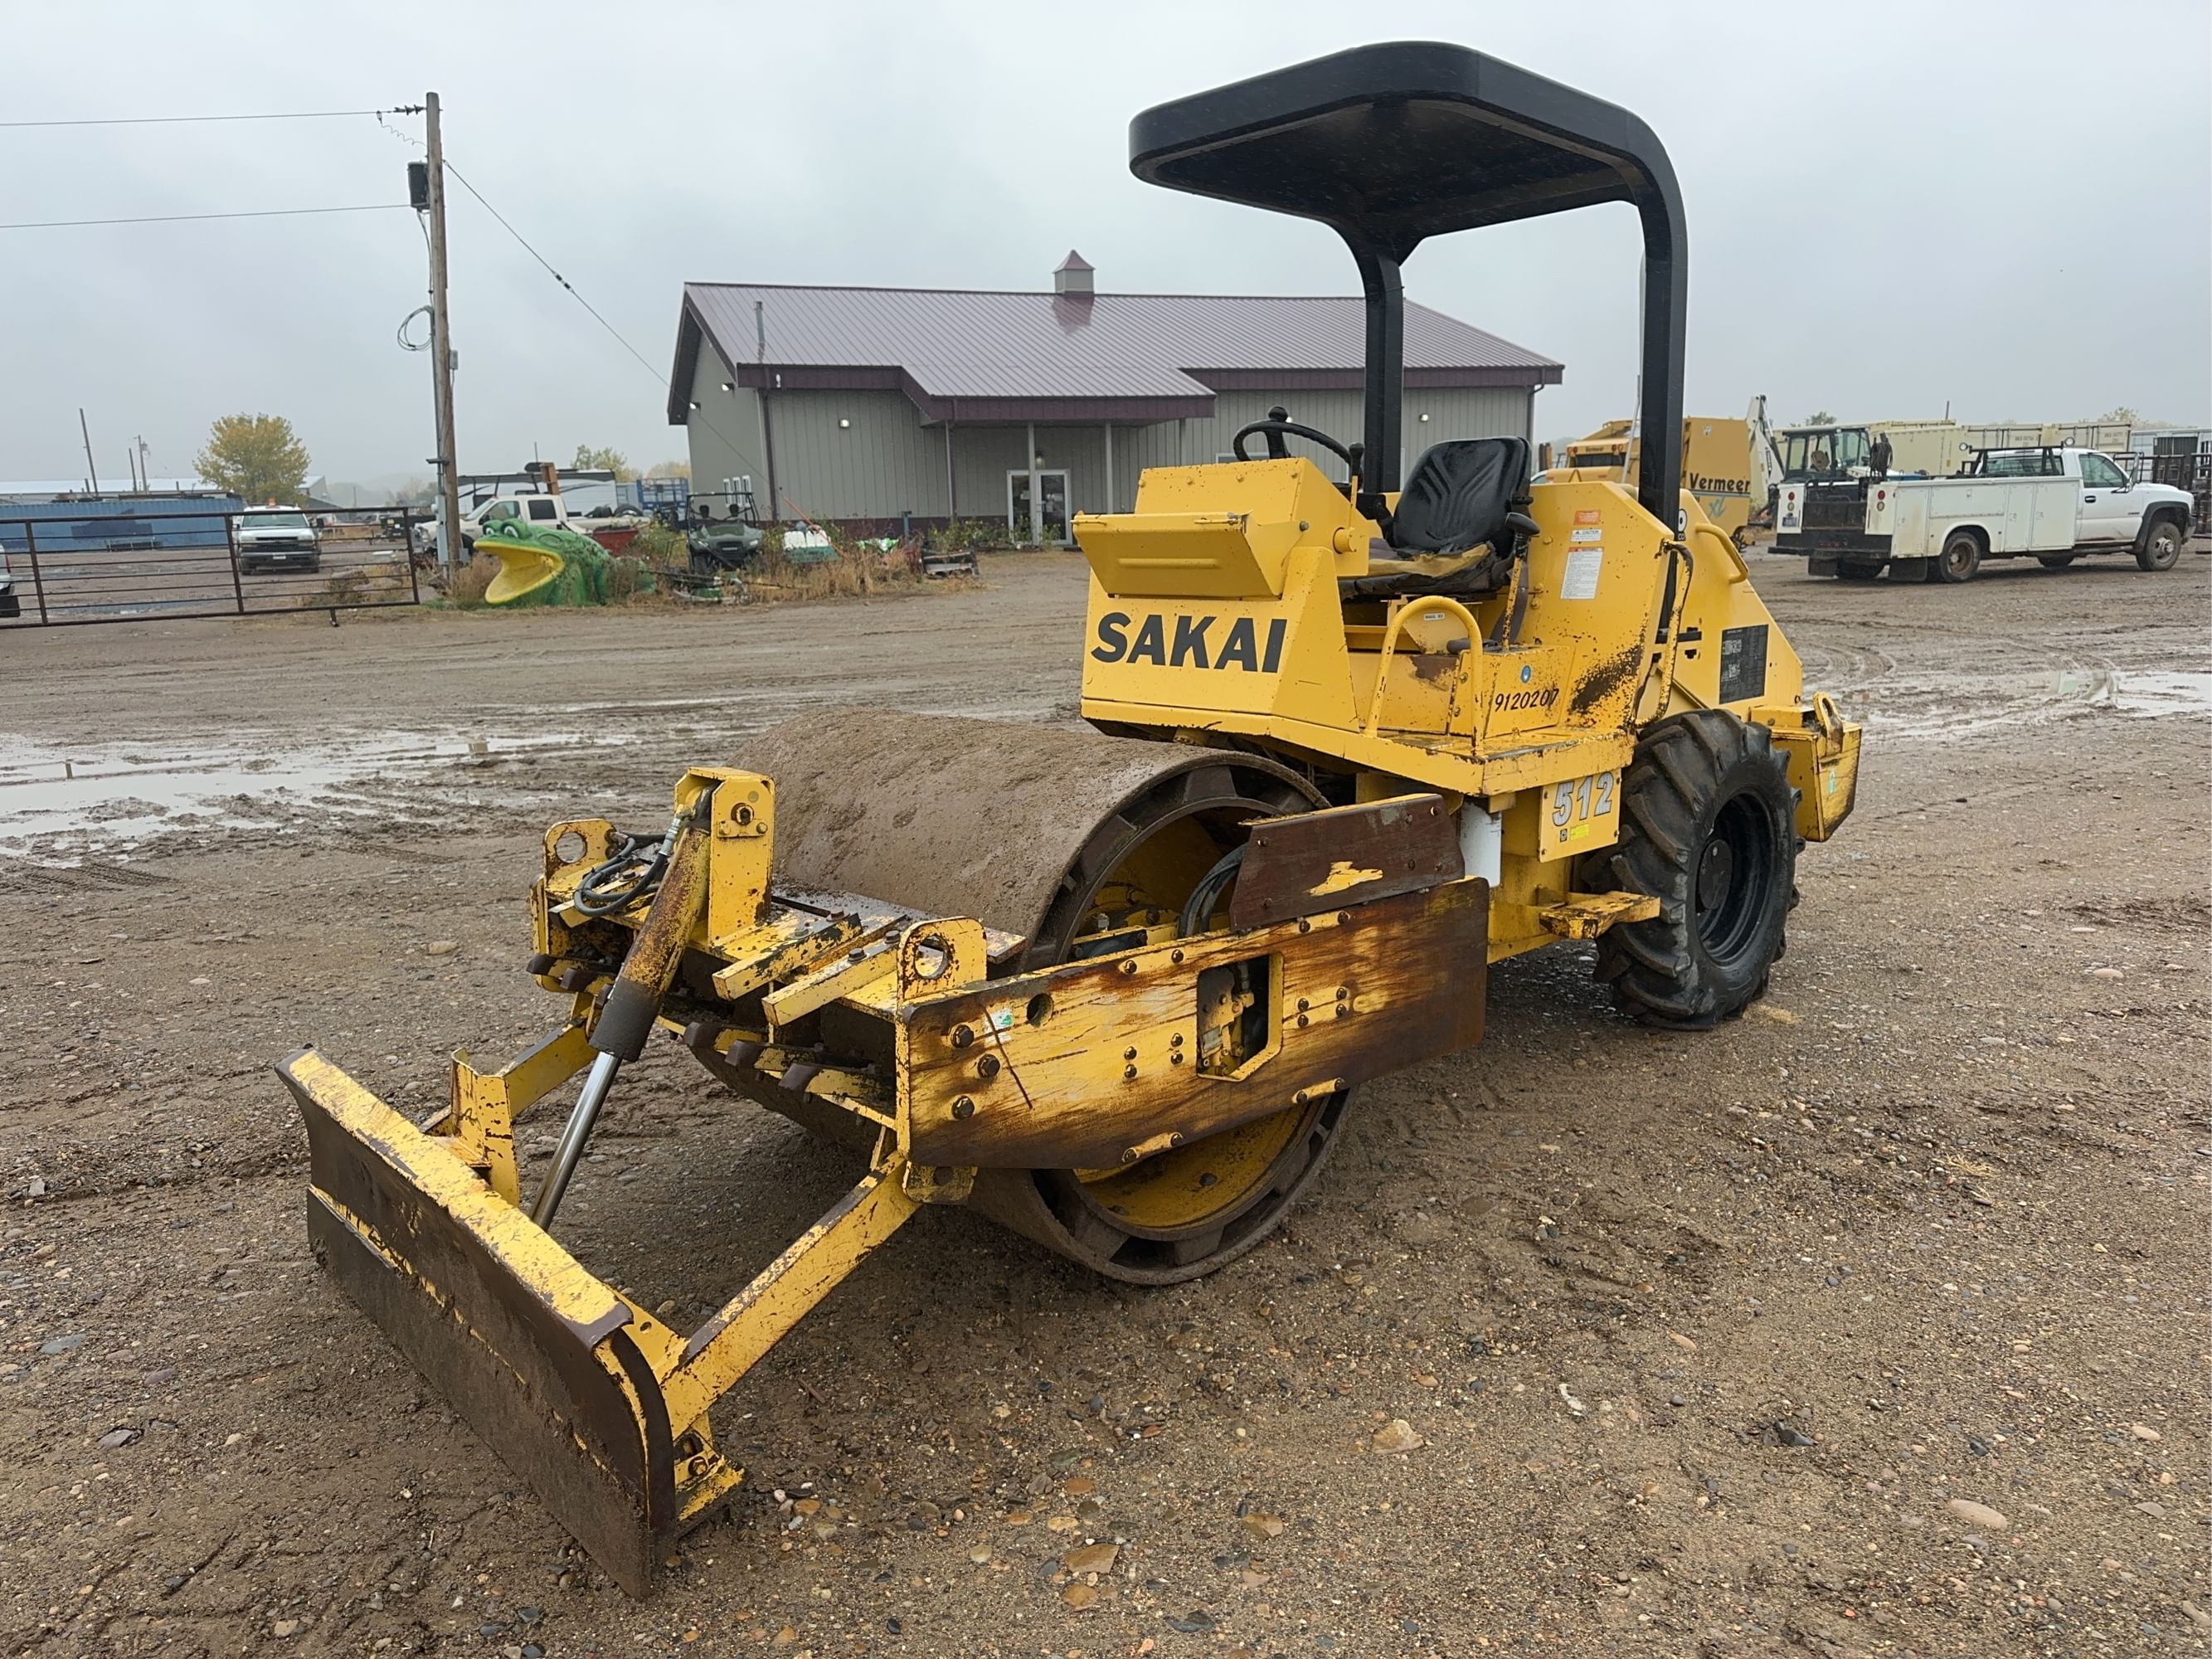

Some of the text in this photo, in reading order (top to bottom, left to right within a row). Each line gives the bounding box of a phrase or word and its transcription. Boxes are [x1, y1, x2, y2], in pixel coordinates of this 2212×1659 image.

[1689, 472, 1751, 492] Vermeer
[1091, 611, 1287, 674] SAKAI
[1495, 688, 1559, 712] 9120207
[1553, 771, 1614, 827] 512
